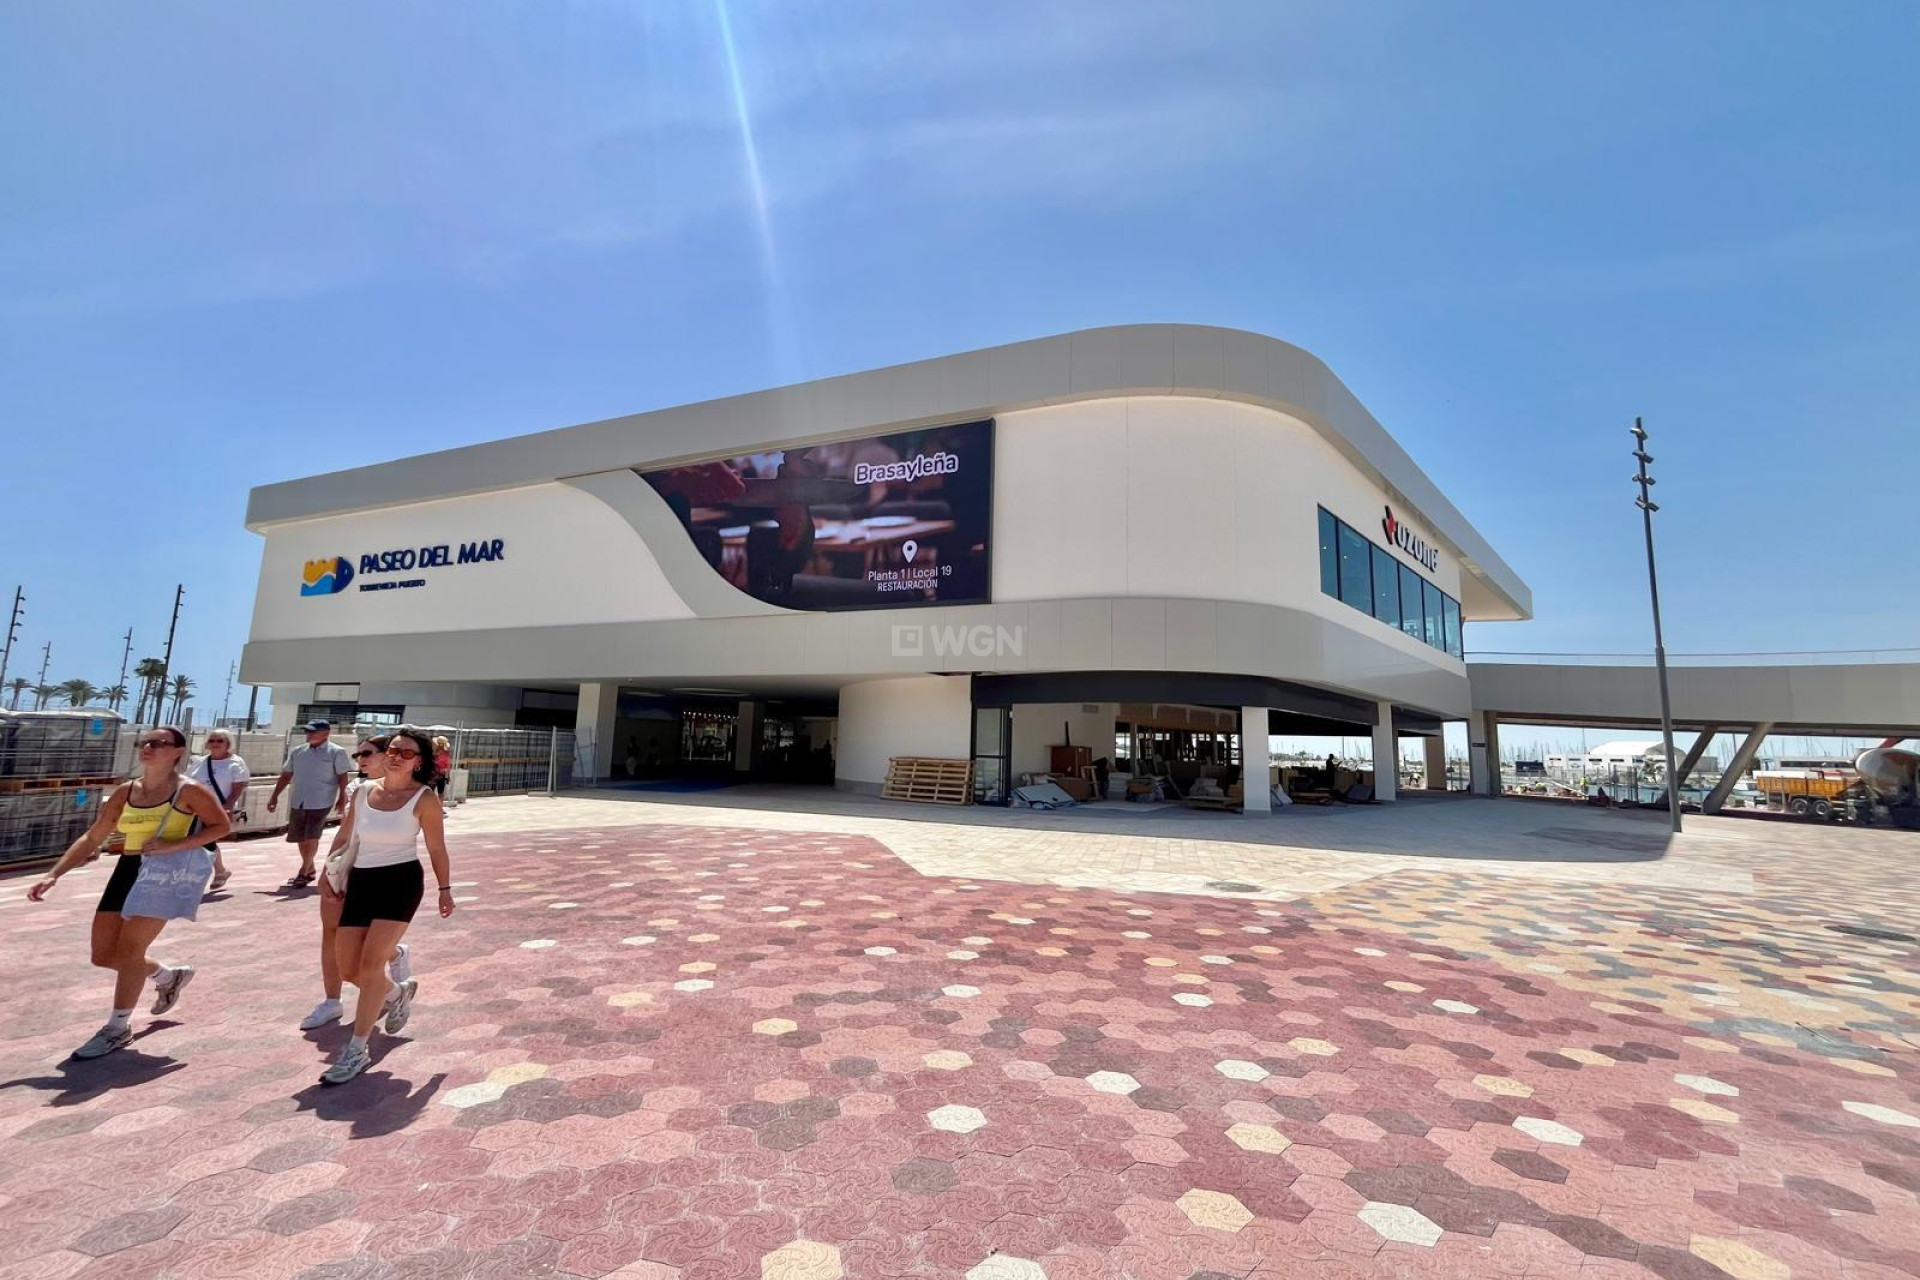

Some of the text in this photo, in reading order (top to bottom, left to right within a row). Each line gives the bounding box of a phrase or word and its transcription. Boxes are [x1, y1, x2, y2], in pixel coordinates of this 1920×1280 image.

[854, 452, 959, 485] Brasayleña
[359, 538, 505, 574] PASEO DEL MAR
[868, 569, 898, 581] Planta
[913, 566, 938, 579] Local
[941, 565, 952, 576] 19
[877, 577, 938, 592] RESTAURACIÓN
